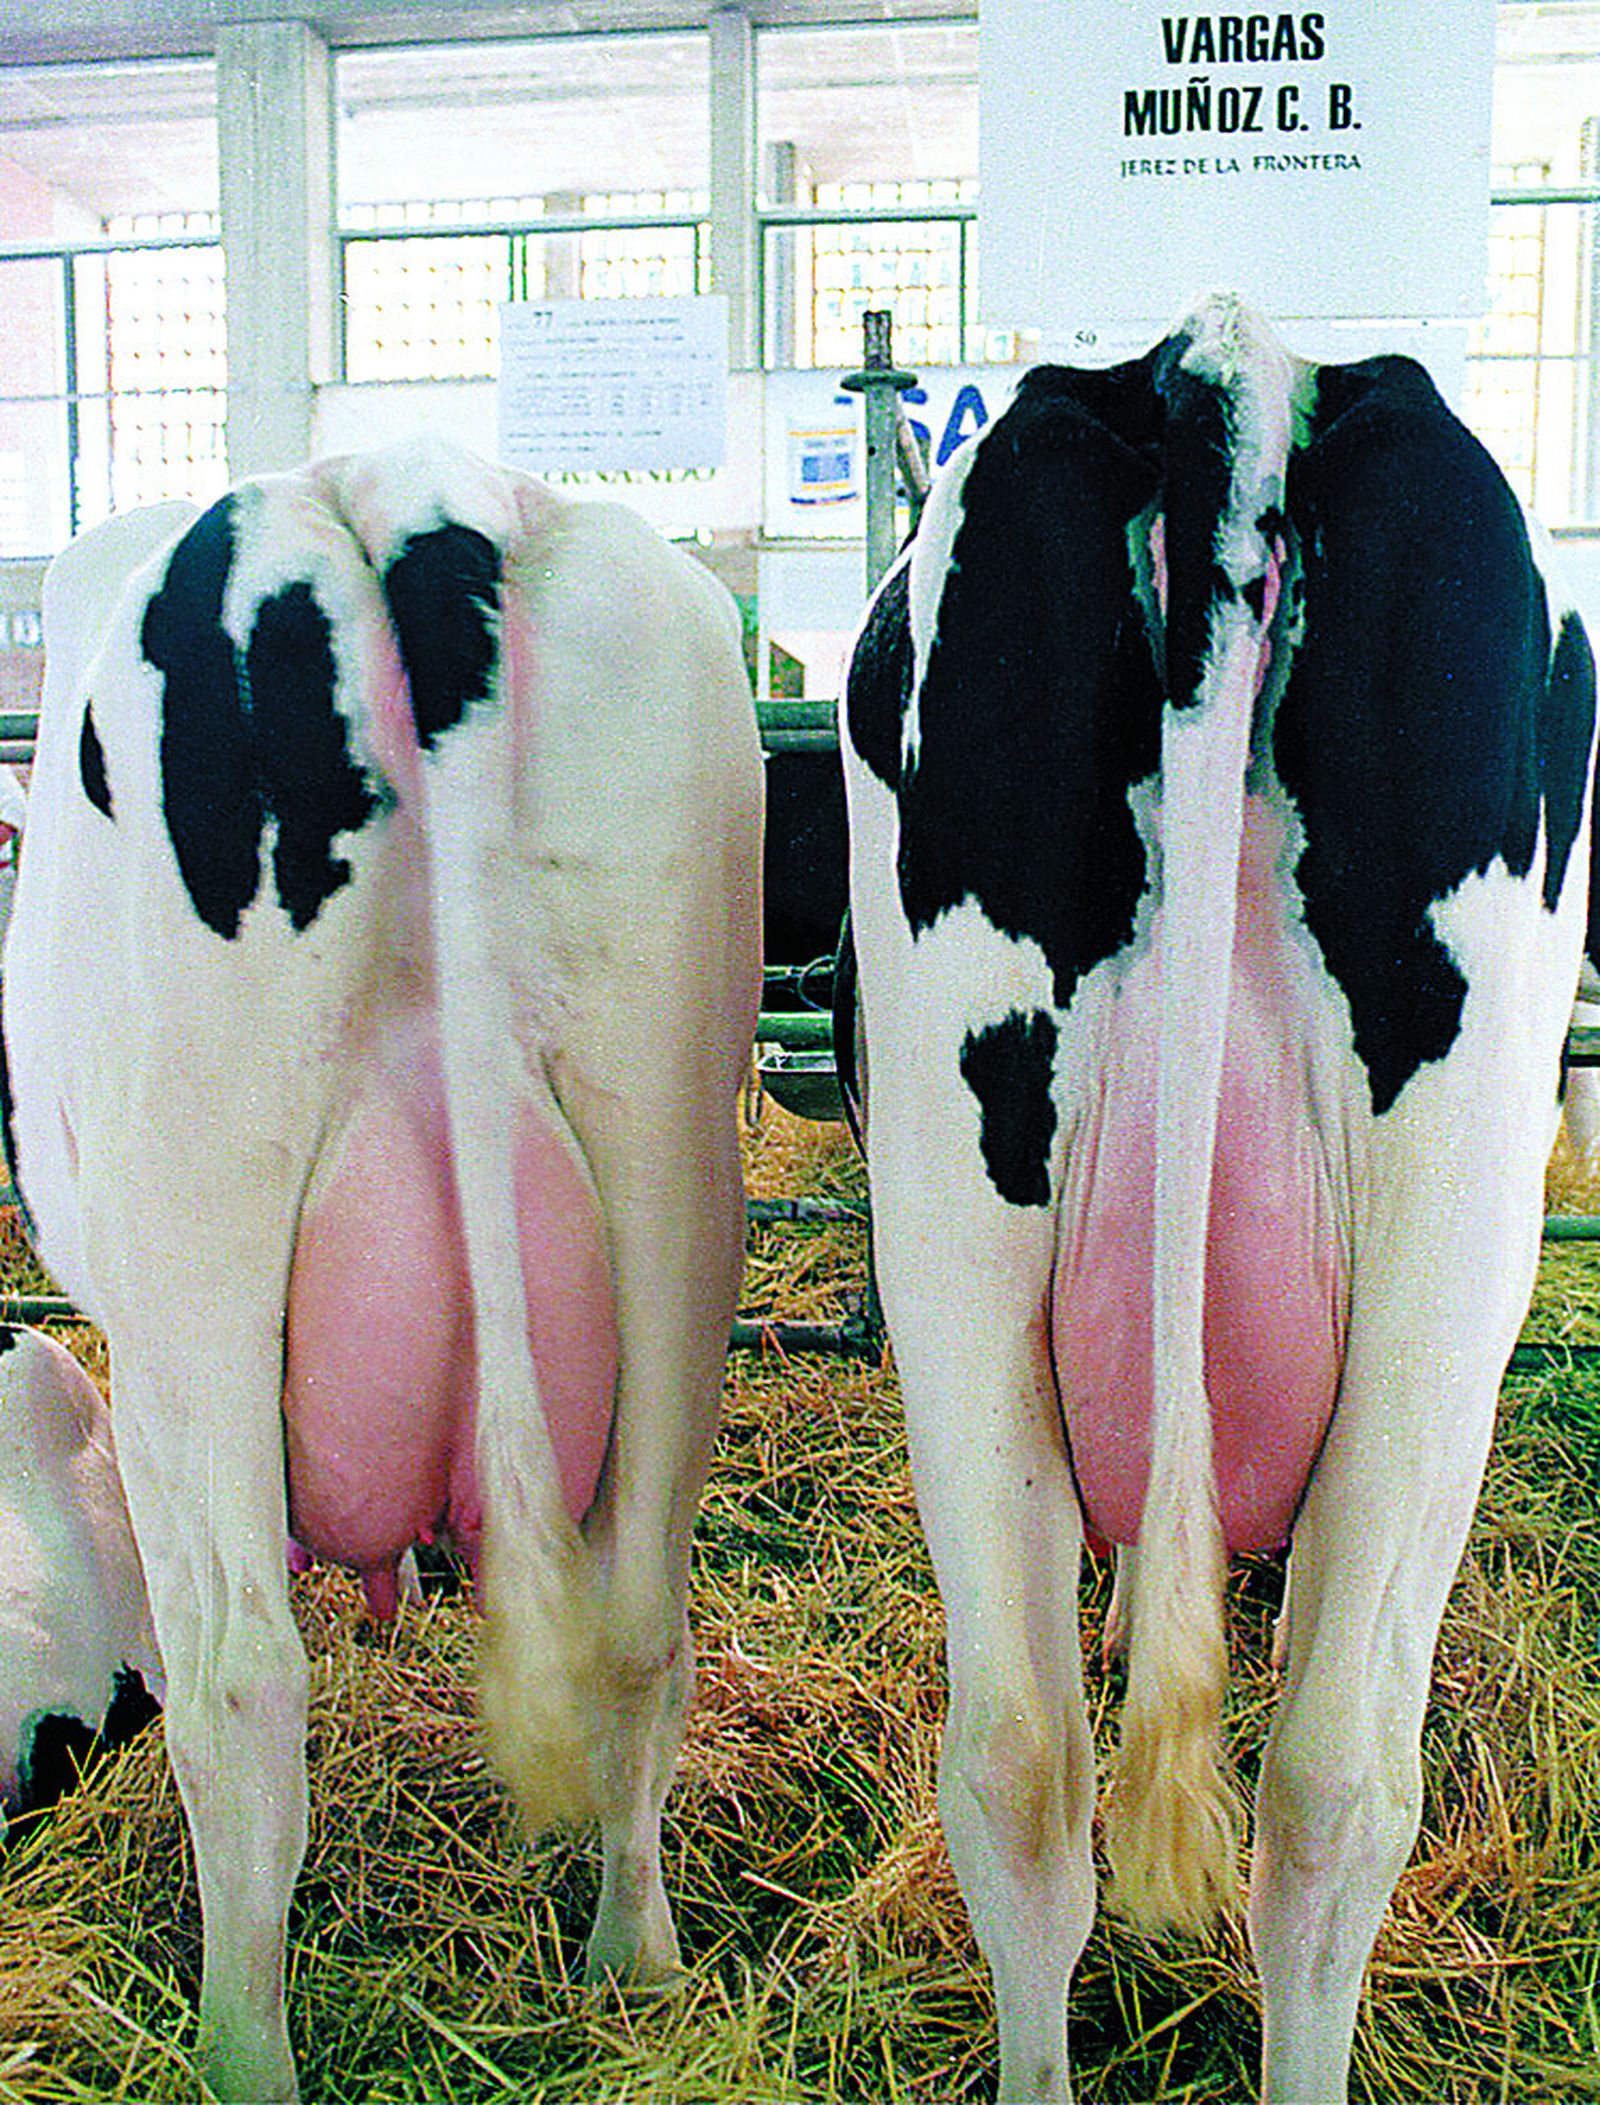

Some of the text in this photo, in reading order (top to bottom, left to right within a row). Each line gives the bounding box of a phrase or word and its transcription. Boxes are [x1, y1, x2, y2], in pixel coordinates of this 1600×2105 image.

[1161, 13, 1325, 64] VARGAS
[1124, 76, 1362, 137] MUÑOZ C. B.
[1120, 153, 1362, 178] JEREZ DE LA FRONTERA
[1075, 330, 1097, 348] 50
